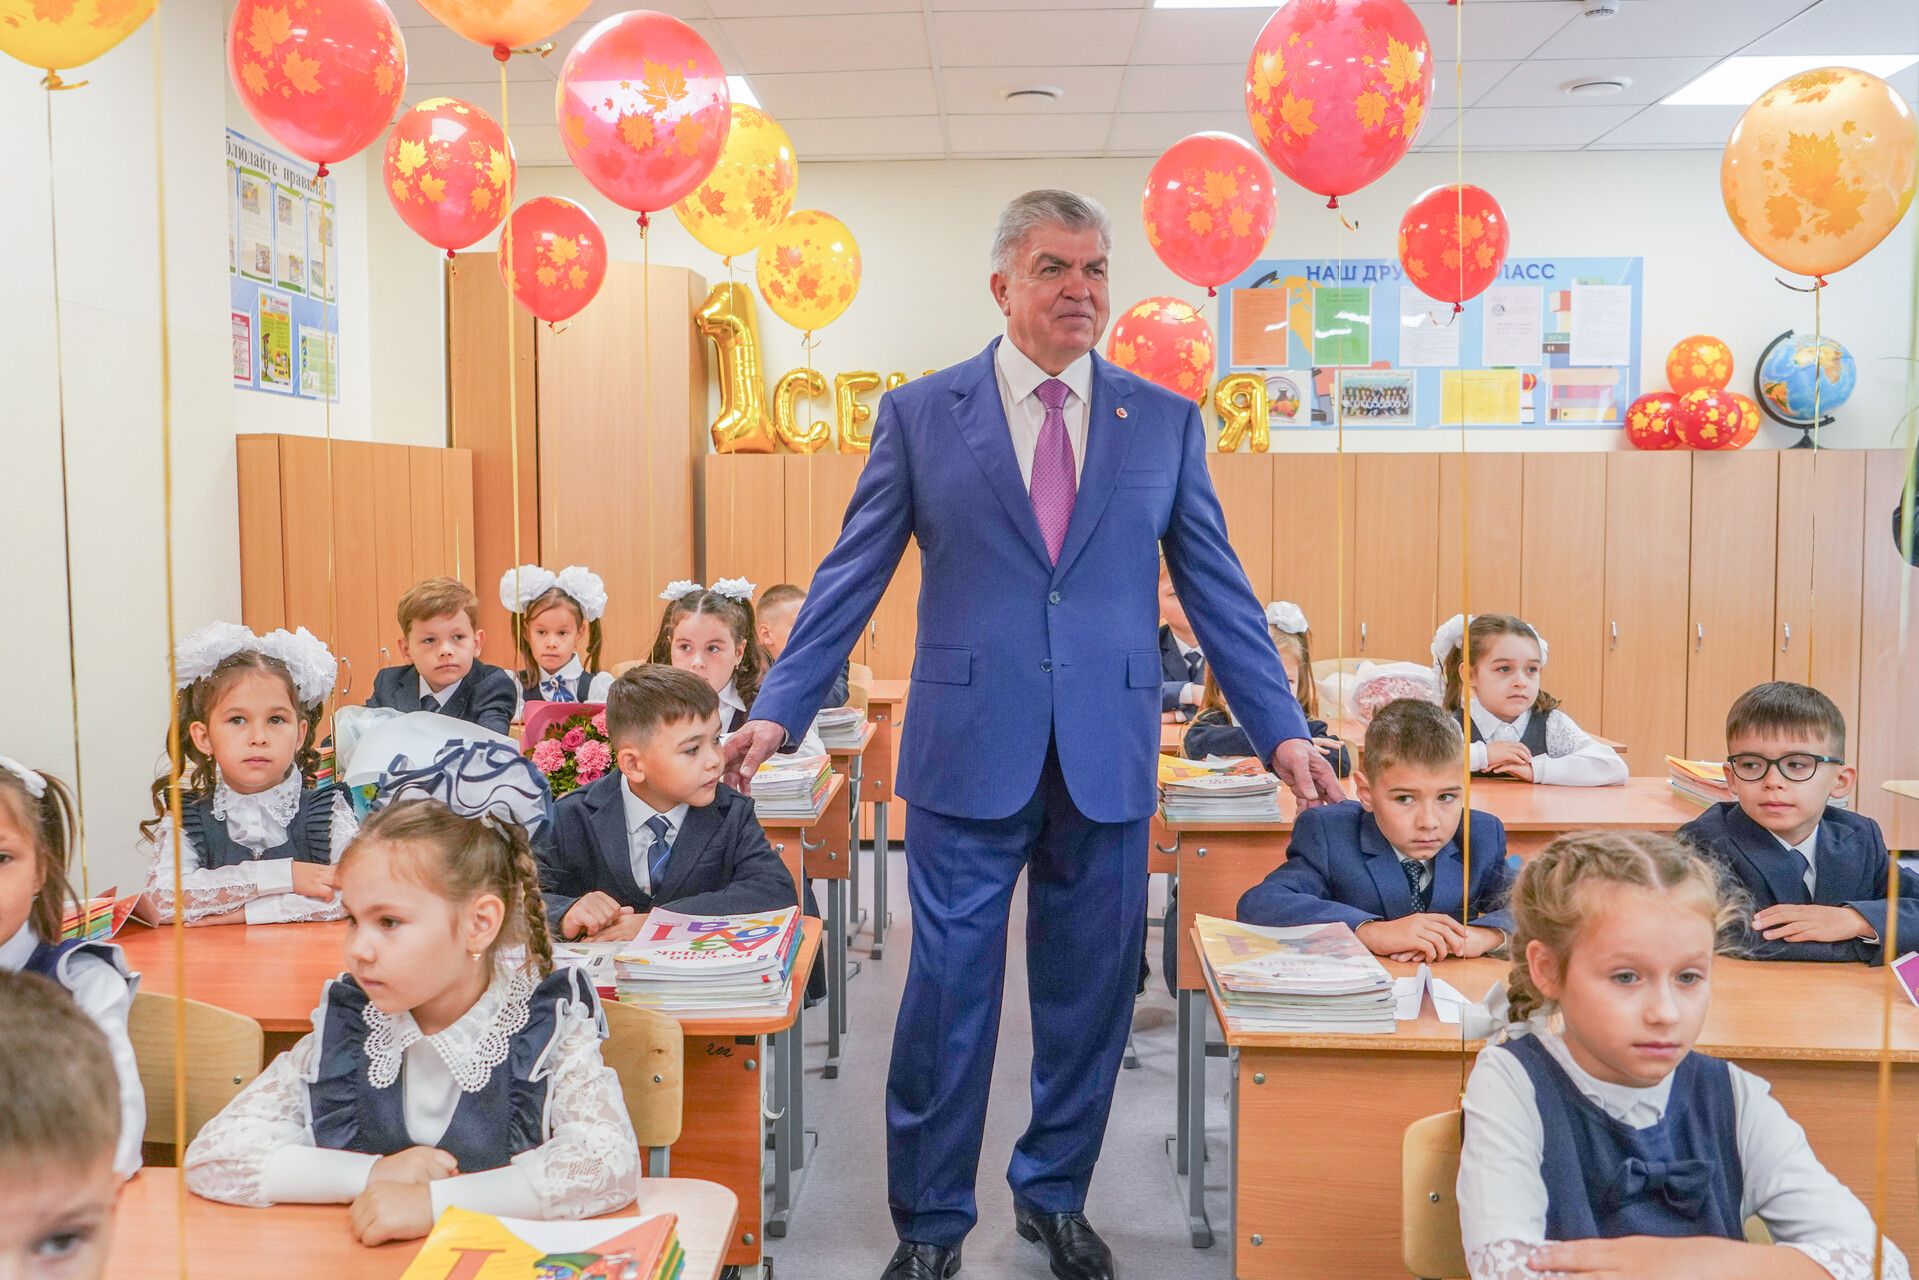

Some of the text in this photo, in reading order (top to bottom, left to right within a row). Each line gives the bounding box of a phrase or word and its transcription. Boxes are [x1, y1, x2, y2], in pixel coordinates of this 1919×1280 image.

[283, 167, 328, 199] правил!
[1306, 265, 1357, 281] НАШ
[694, 281, 777, 454] 1
